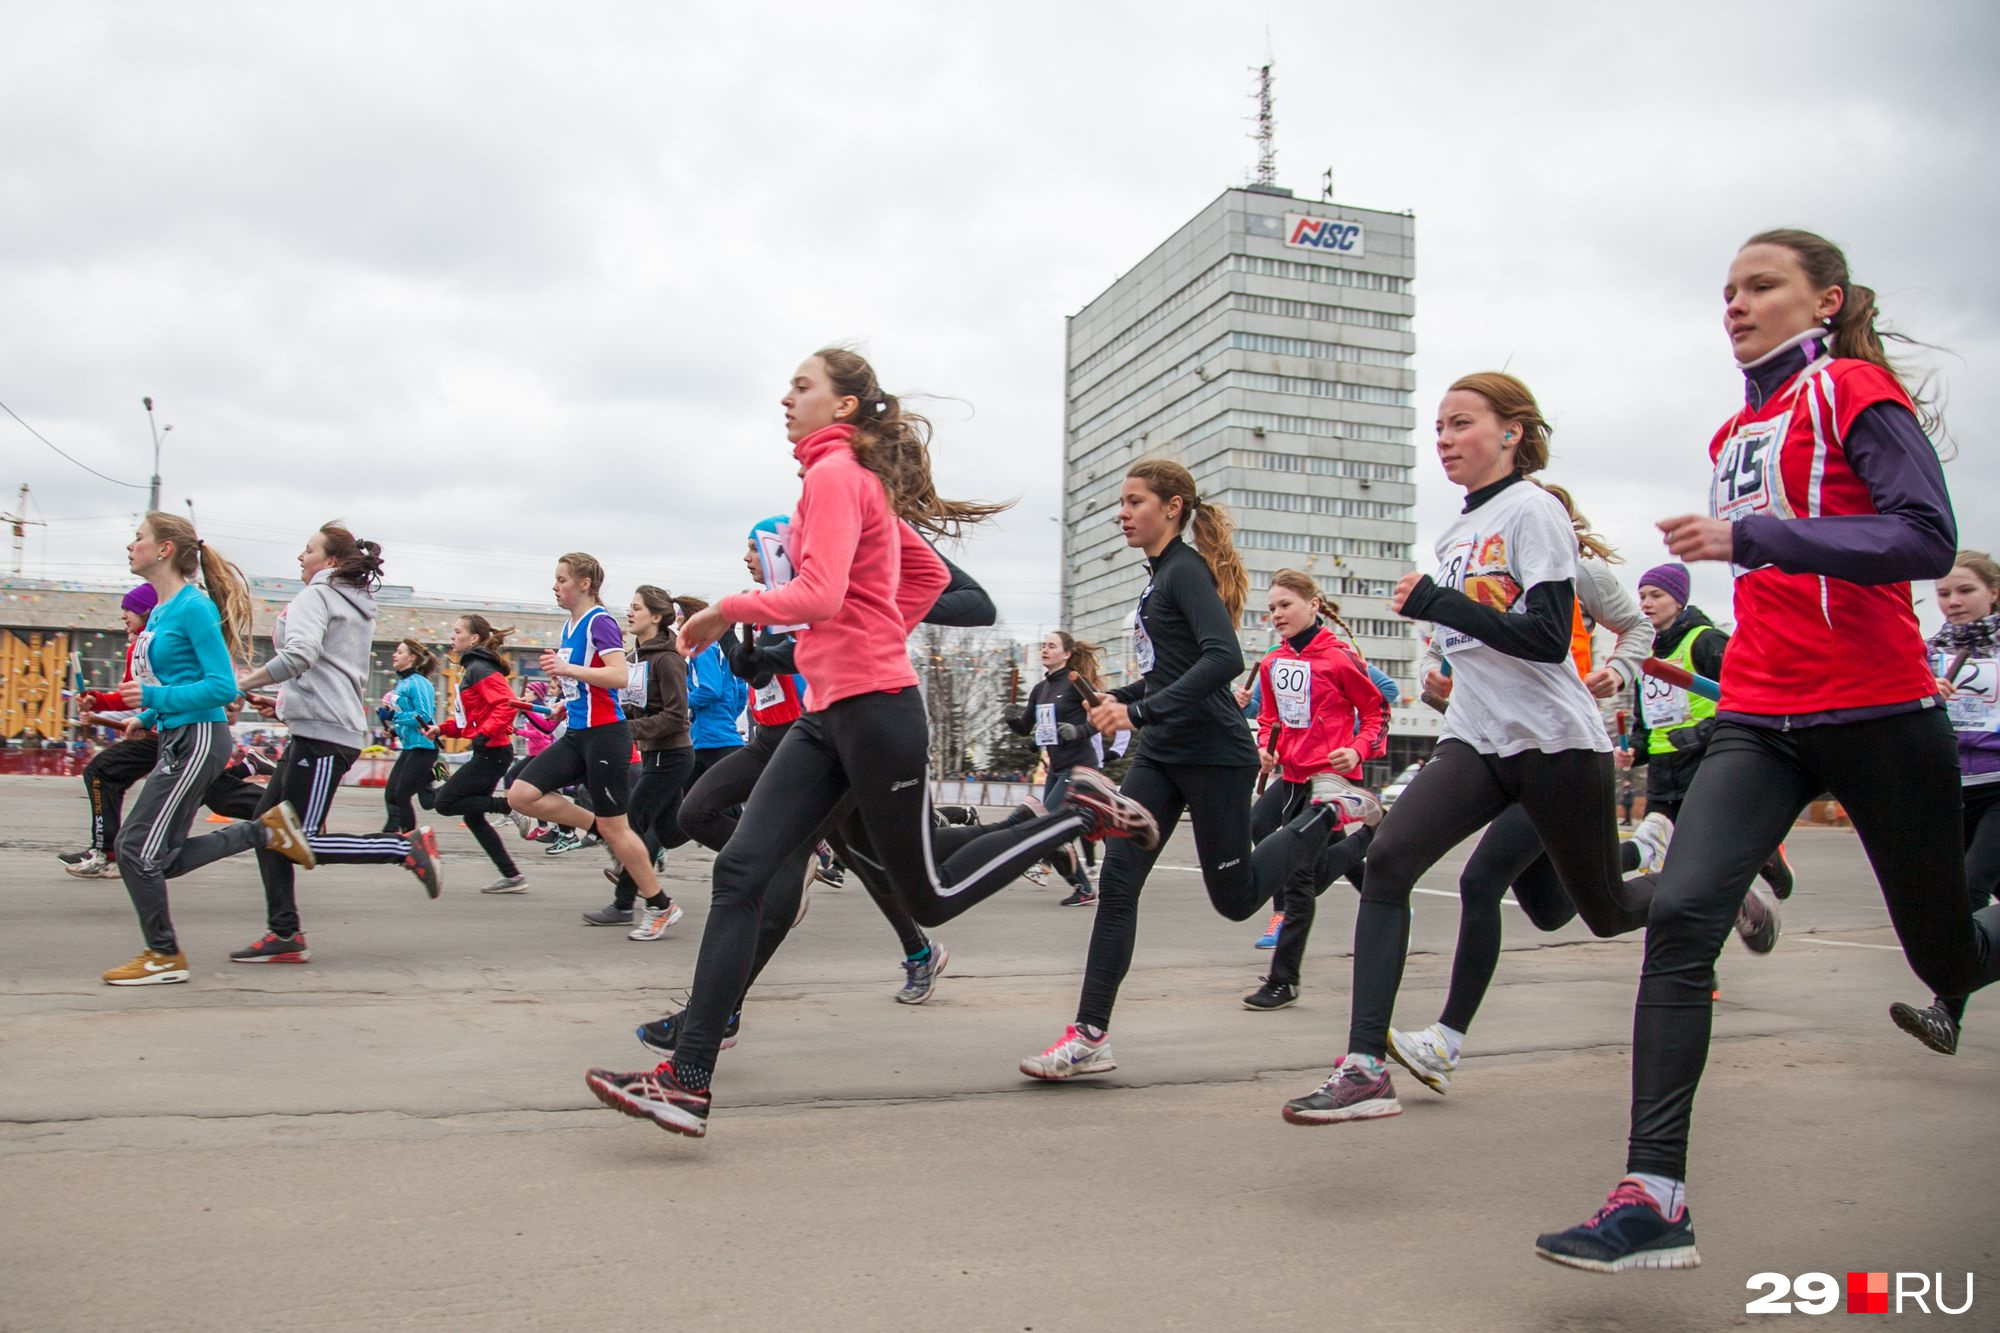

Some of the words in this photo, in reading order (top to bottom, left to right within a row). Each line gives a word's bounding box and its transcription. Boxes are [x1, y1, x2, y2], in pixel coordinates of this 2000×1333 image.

[1720, 435, 1771, 502] 45
[1277, 668, 1304, 692] 30
[1956, 662, 1989, 694] 2
